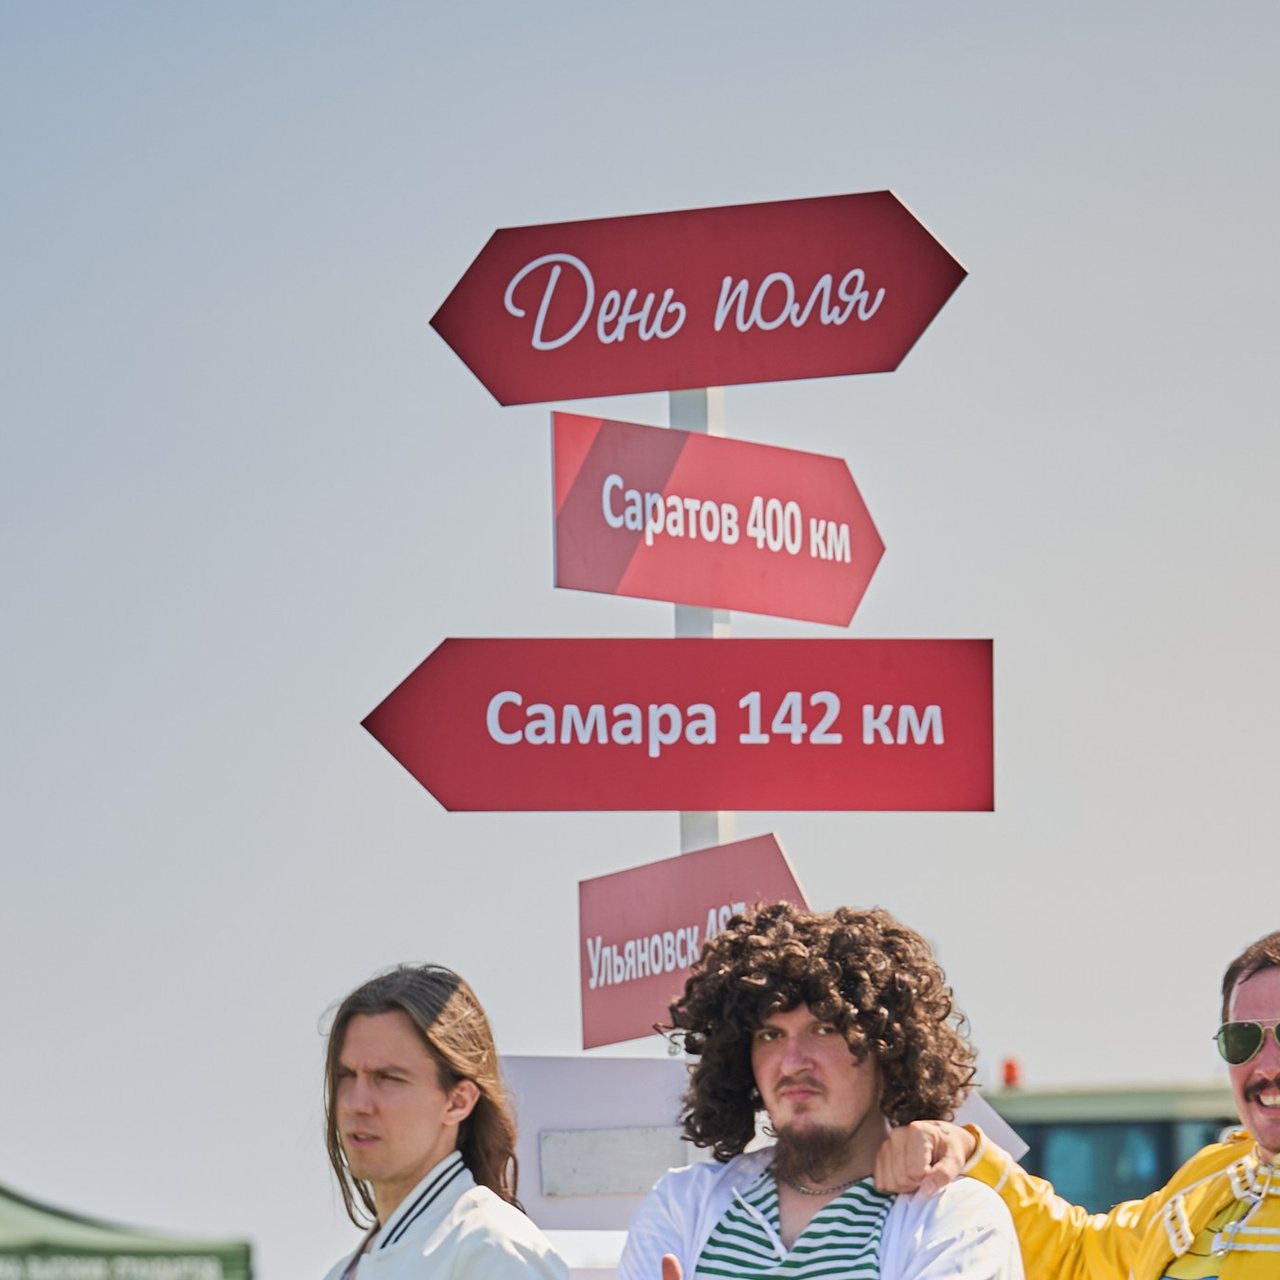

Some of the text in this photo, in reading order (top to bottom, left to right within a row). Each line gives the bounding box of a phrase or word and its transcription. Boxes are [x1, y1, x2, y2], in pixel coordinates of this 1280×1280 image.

[504, 252, 886, 351] День поля
[602, 473, 852, 564] Саратов 400 км
[486, 690, 945, 758] Самара 142 км
[586, 925, 701, 990] Ульяновск
